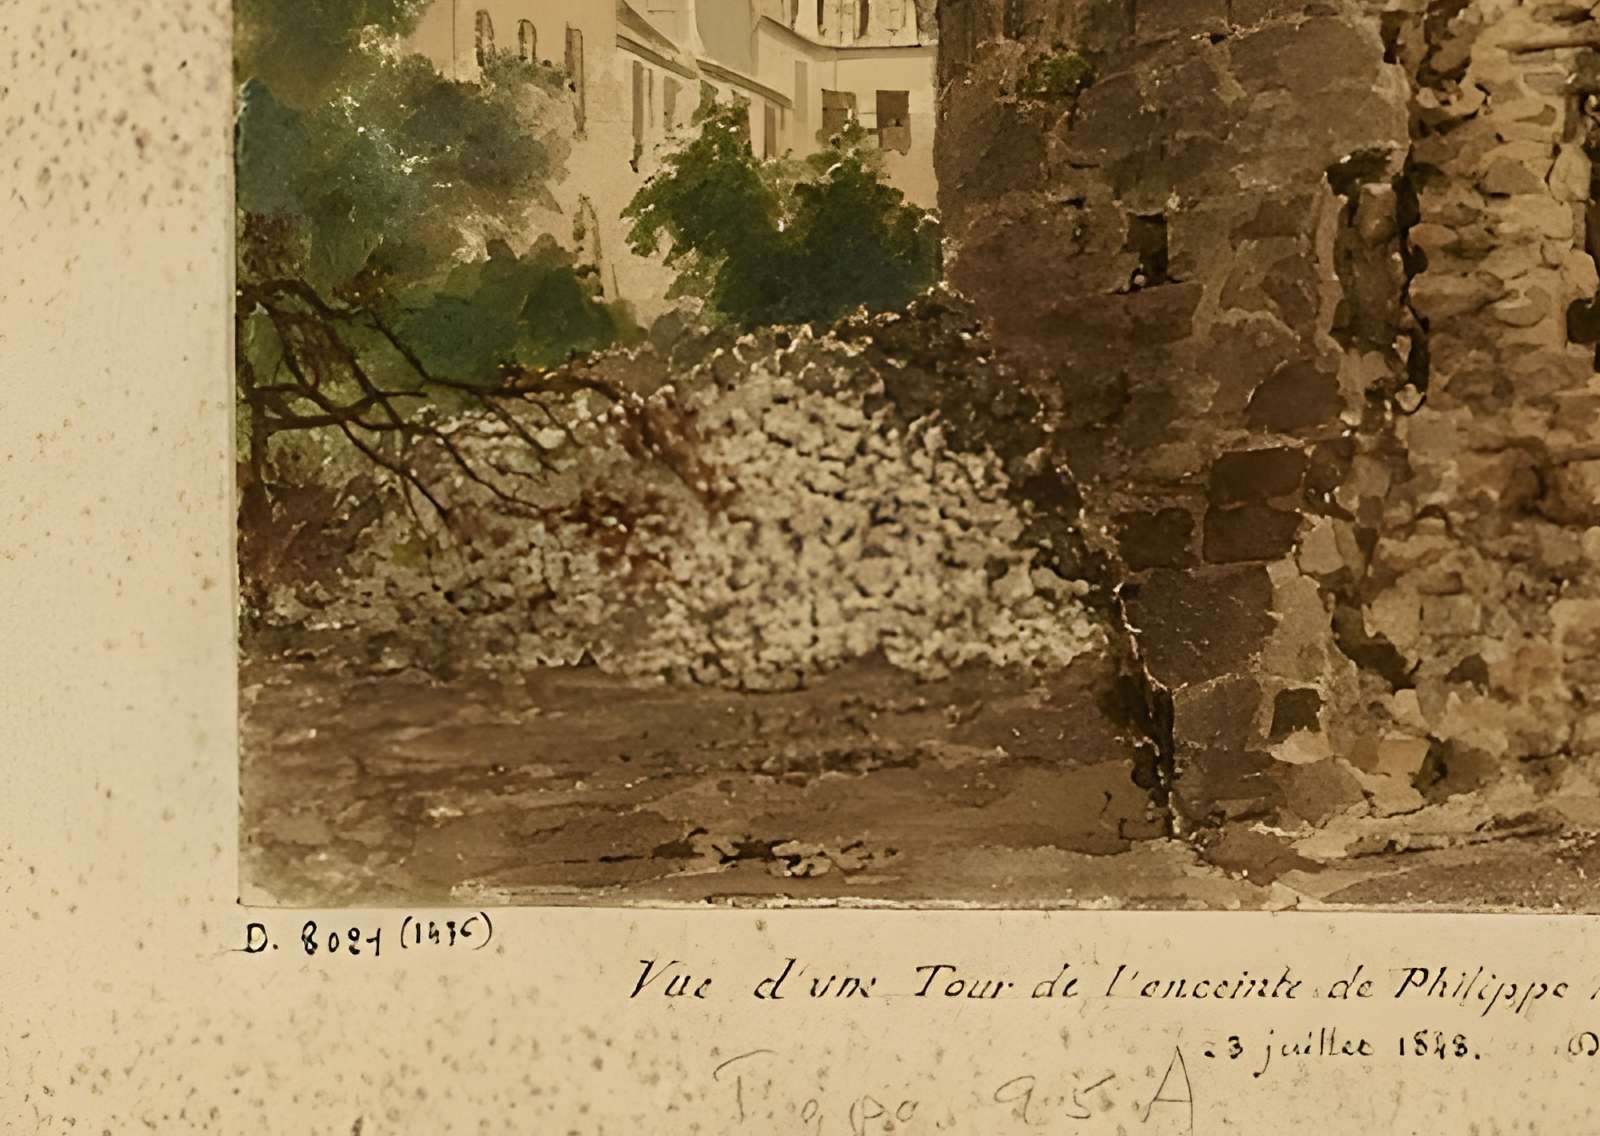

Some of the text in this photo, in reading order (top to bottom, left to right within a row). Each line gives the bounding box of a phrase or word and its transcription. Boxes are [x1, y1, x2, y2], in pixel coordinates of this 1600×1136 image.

[246, 922, 279, 954] D.
[629, 959, 711, 1000] Vue
[753, 958, 879, 1000] d'une
[915, 964, 1013, 1000] Tour
[1031, 962, 1080, 1000] de
[1105, 964, 1302, 1000] l'enceinte
[1327, 962, 1375, 1000] de
[1394, 966, 1567, 1016] Philippe
